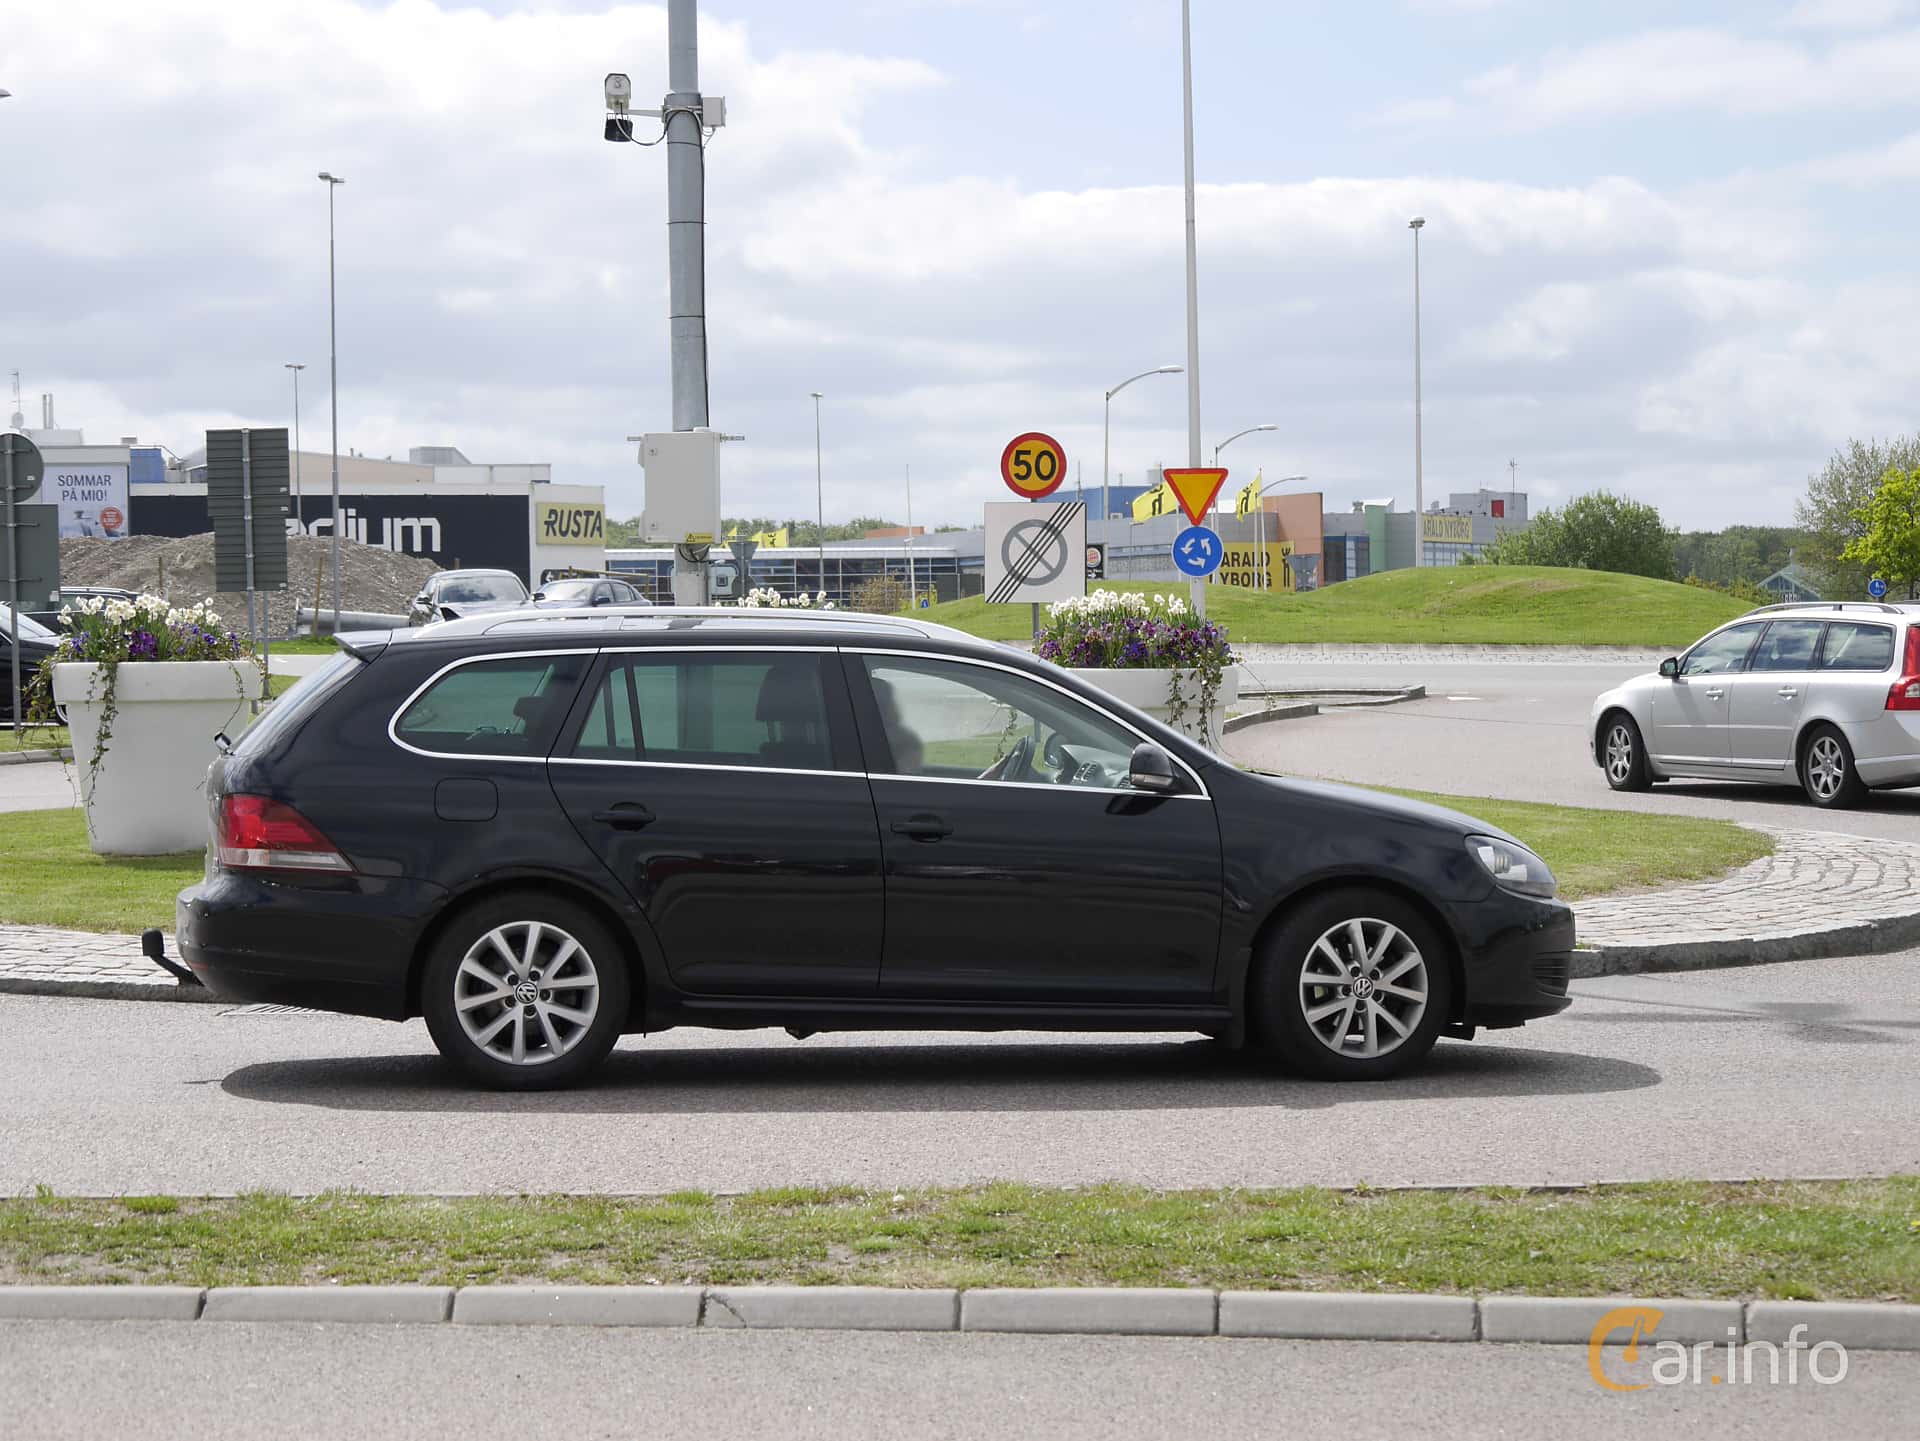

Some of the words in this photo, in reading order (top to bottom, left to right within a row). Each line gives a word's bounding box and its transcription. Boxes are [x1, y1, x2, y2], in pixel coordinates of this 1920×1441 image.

[1013, 450, 1057, 481] 50
[57, 474, 112, 487] SOMMAR
[62, 487, 78, 501] PÅ
[81, 489, 108, 502] MIO!
[544, 508, 603, 538] RUSTA
[1423, 519, 1443, 537] ARALD
[1220, 551, 1271, 568] ARALD
[1209, 571, 1273, 588] YBORG
